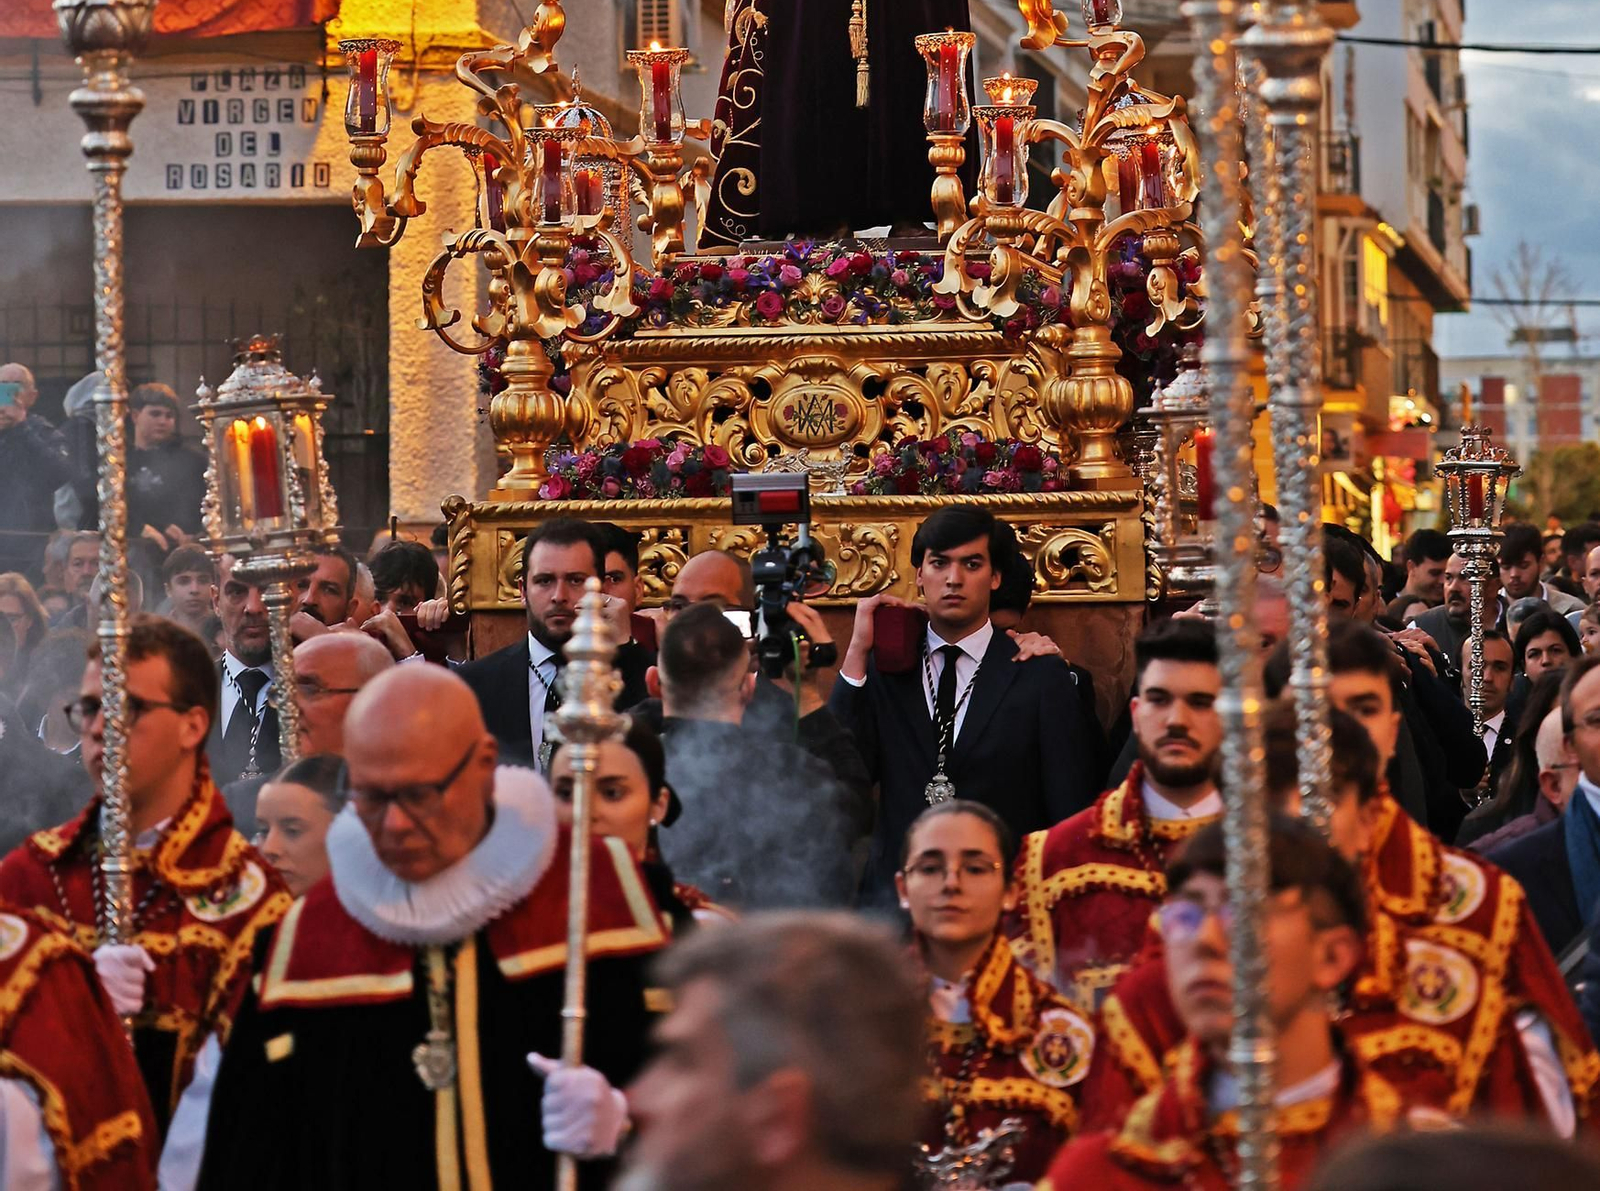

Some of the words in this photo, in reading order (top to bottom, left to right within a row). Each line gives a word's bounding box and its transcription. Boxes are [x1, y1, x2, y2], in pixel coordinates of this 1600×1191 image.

[190, 65, 306, 92] PLAZA
[178, 98, 318, 125] VIRGEN
[215, 131, 281, 157] DEL
[166, 162, 330, 190] ROSARIO
